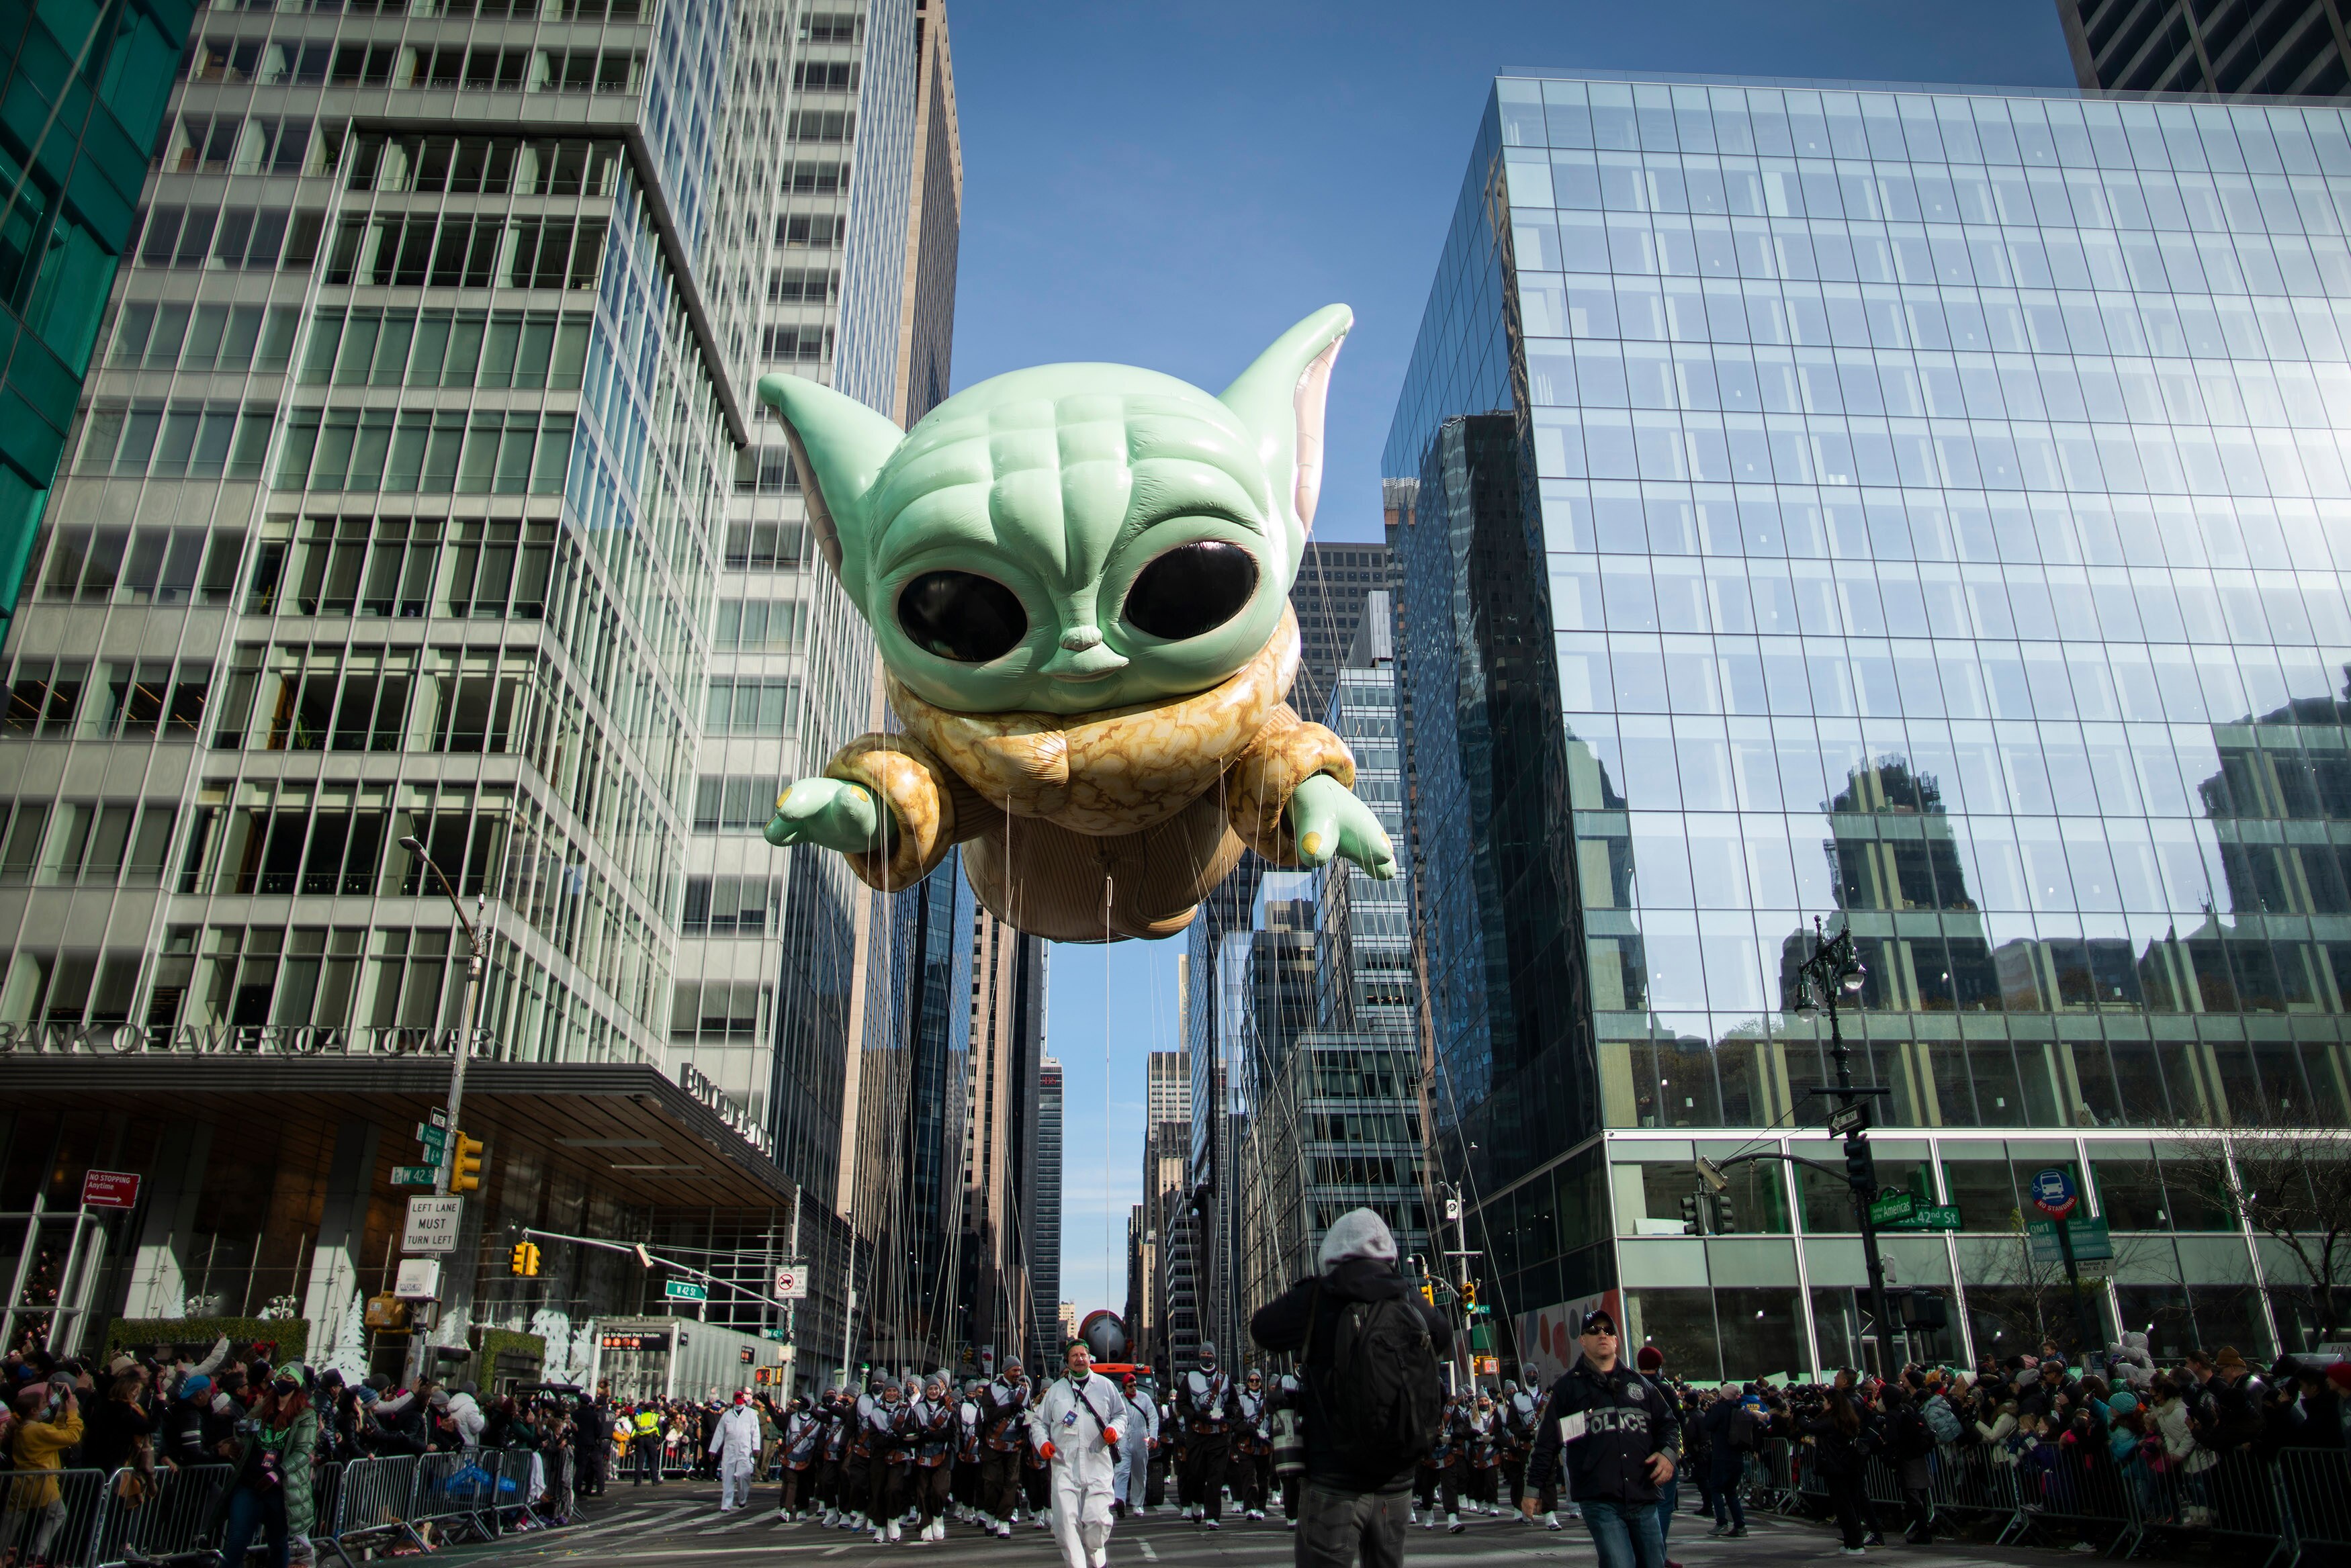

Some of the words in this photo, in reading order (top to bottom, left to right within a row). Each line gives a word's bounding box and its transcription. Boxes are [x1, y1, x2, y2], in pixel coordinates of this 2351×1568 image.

[169, 1023, 350, 1055] AMERICA
[1833, 1117, 1843, 1127] ONE
[1845, 1111, 1856, 1123] WAY
[431, 1149, 435, 1162] 6
[100, 1174, 130, 1184] STOPPING
[404, 1170, 411, 1182] W
[413, 1169, 425, 1182] 42
[88, 1182, 114, 1190] Anytime
[412, 1203, 432, 1212] LEFT
[436, 1203, 457, 1212] LANE
[1883, 1199, 1911, 1217] Americas
[2037, 1200, 2047, 1209] NO
[2047, 1196, 2075, 1212] STANDING
[1918, 1211, 1941, 1224] 42nd
[1944, 1211, 1957, 1224] St
[418, 1219, 447, 1229] MUST
[2030, 1222, 2049, 1234] QM1
[408, 1236, 429, 1244] TURN
[433, 1236, 452, 1244] LEFT
[2033, 1236, 2053, 1247] QM5
[2036, 1249, 2058, 1260] QM6
[676, 1285, 682, 1294] W
[682, 1286, 689, 1296] 42
[690, 1287, 696, 1297] St
